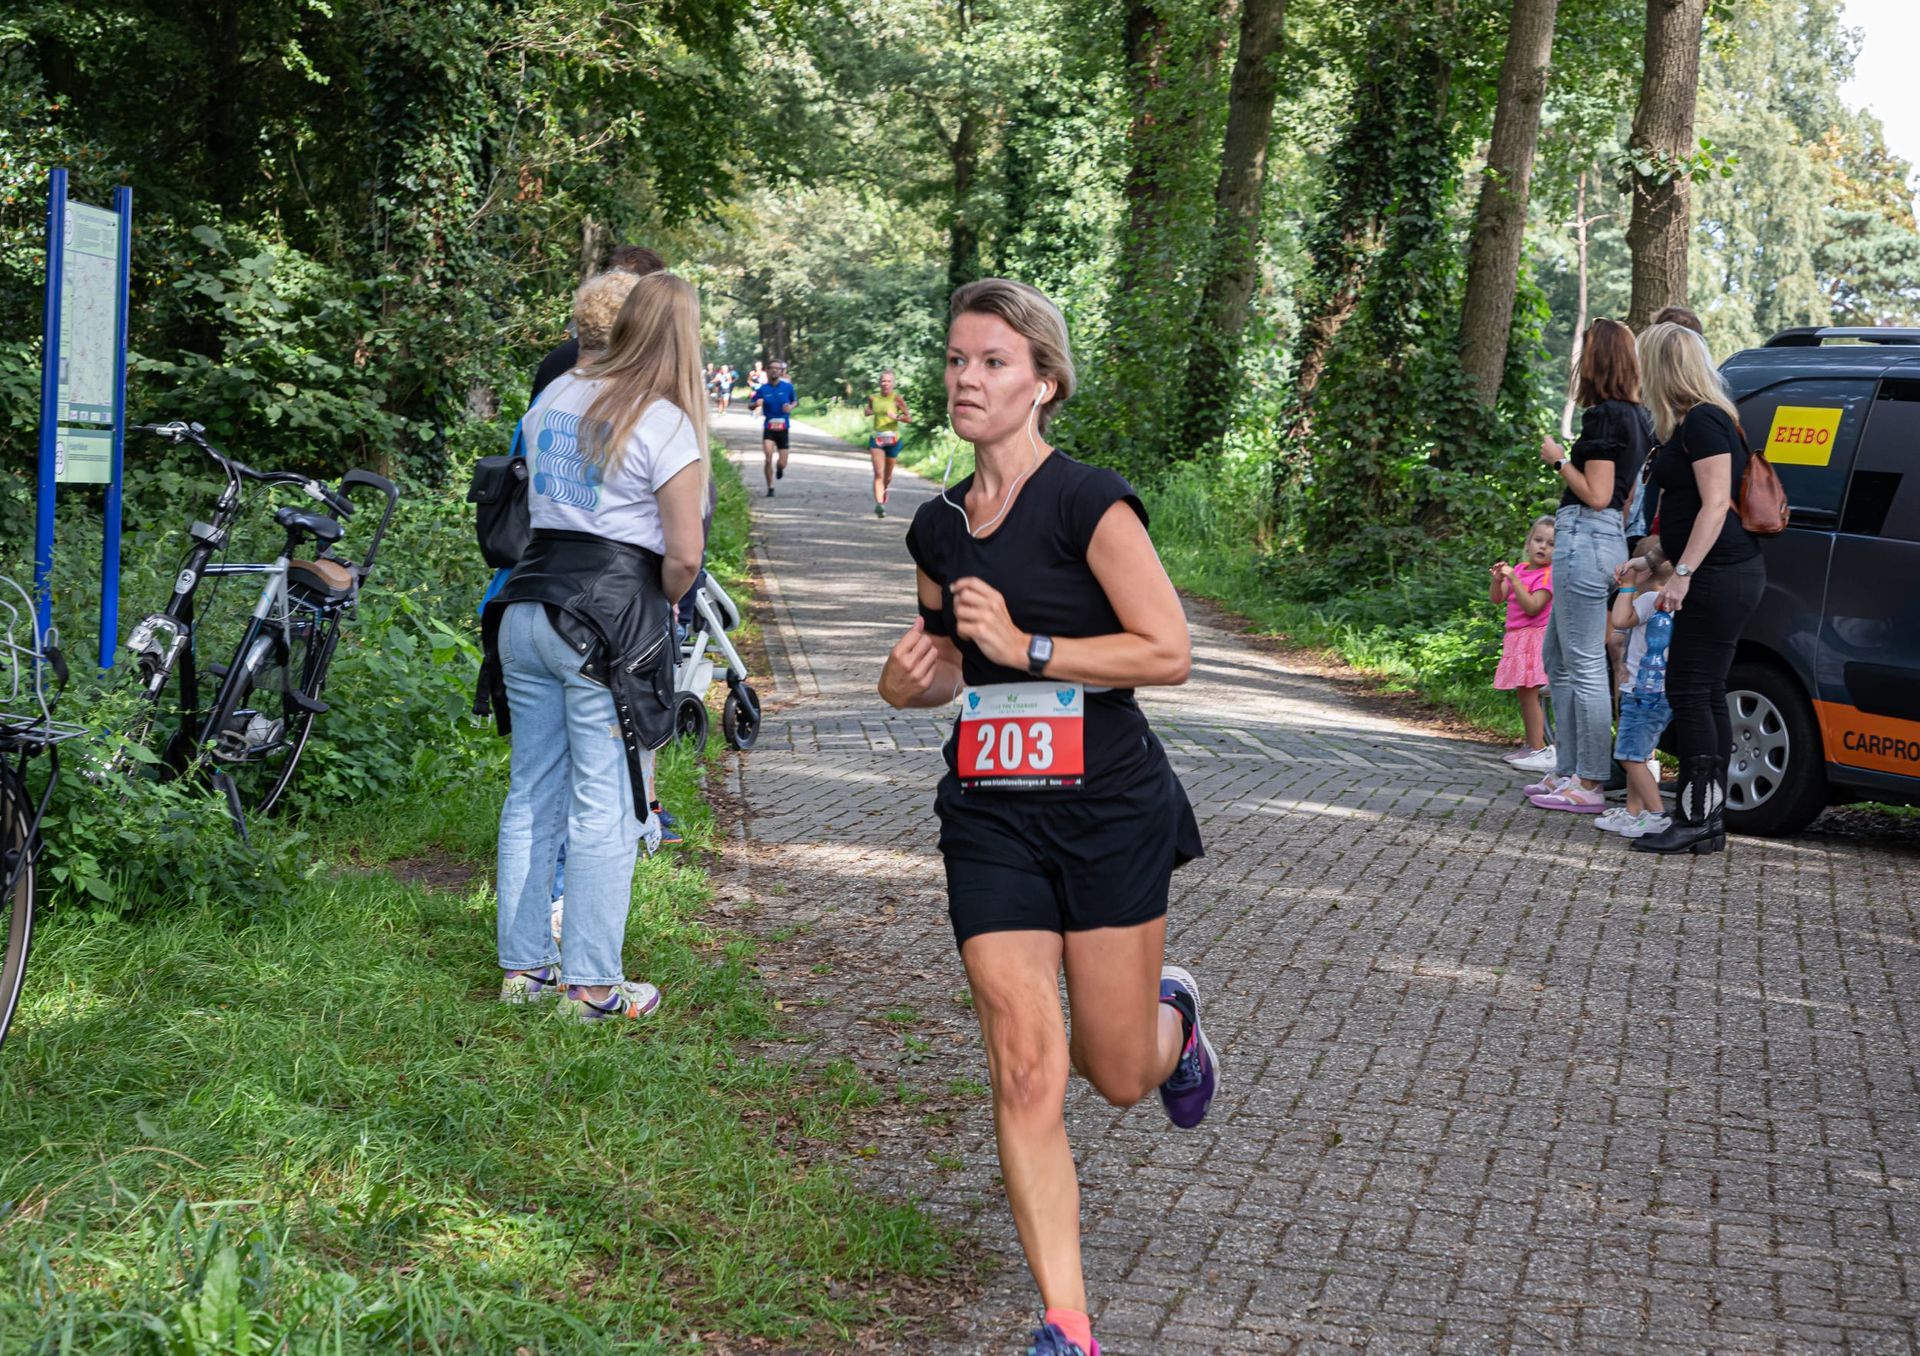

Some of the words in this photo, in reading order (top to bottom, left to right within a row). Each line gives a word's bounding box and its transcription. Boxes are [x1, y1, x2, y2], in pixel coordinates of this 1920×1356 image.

[1774, 426, 1830, 445] EHBO
[975, 721, 1054, 771] 203
[1843, 730, 1920, 762] CARPRO
